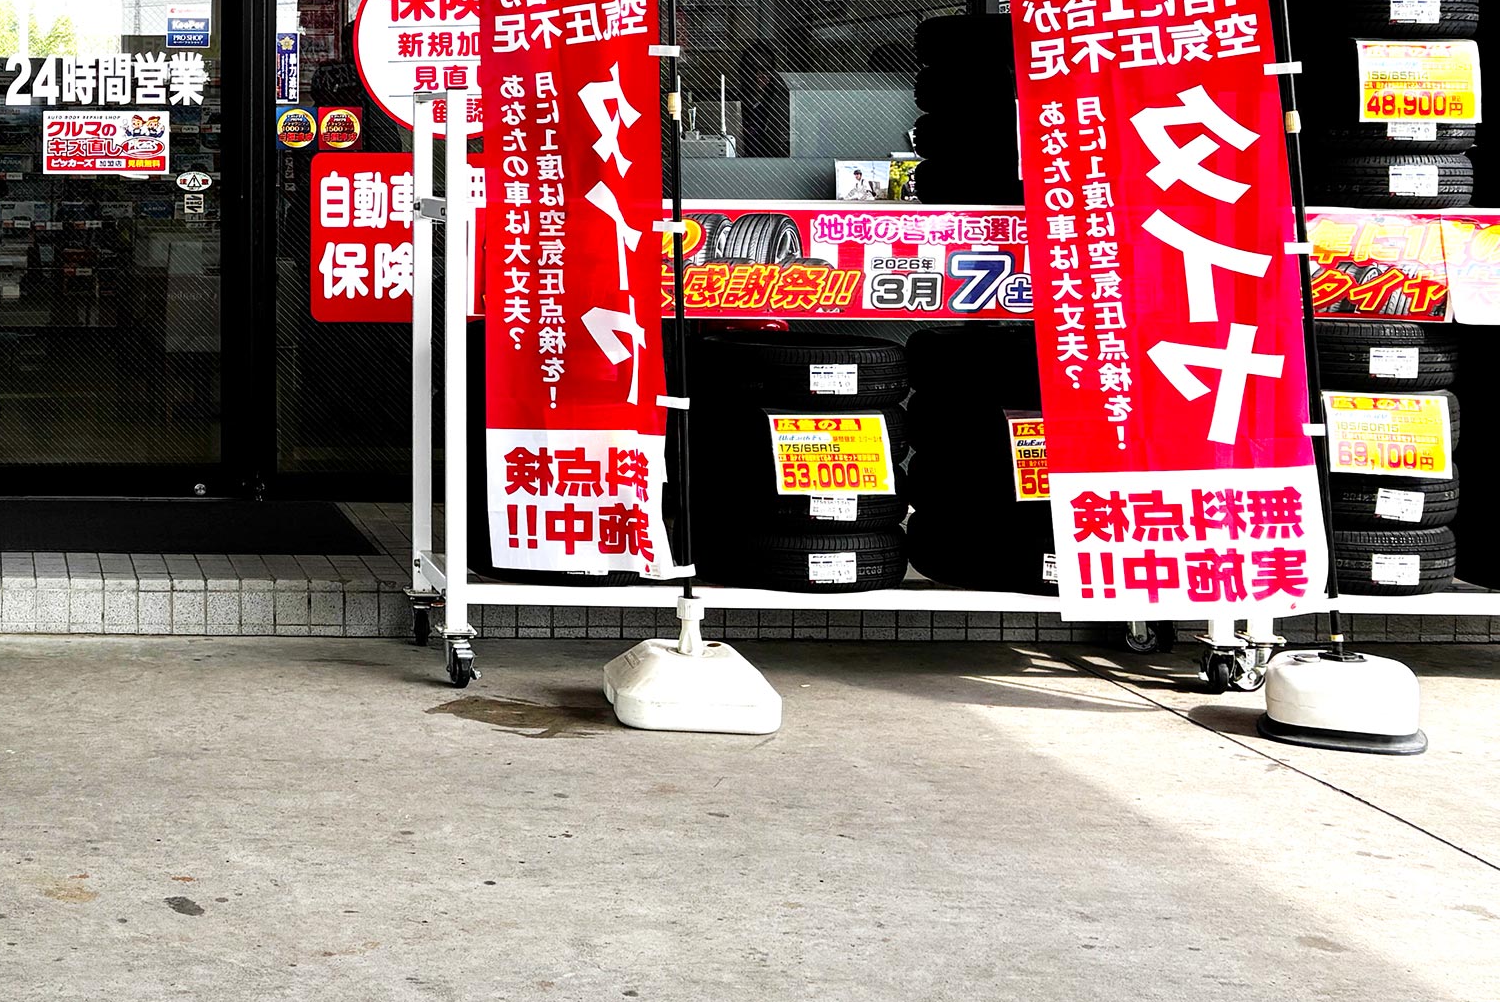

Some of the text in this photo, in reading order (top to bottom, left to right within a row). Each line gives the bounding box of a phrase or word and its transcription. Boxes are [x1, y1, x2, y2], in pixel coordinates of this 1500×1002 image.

[4, 51, 206, 107] 24時間営業
[47, 121, 117, 137] クルマの
[48, 139, 122, 156] キズ直し
[51, 158, 95, 168] ピッカーズ
[319, 241, 414, 299] 保険
[872, 257, 935, 271] 2026年
[1311, 268, 1449, 312] タイヤ
[780, 443, 841, 453] 175/65R15
[782, 462, 877, 490] 53,000円
